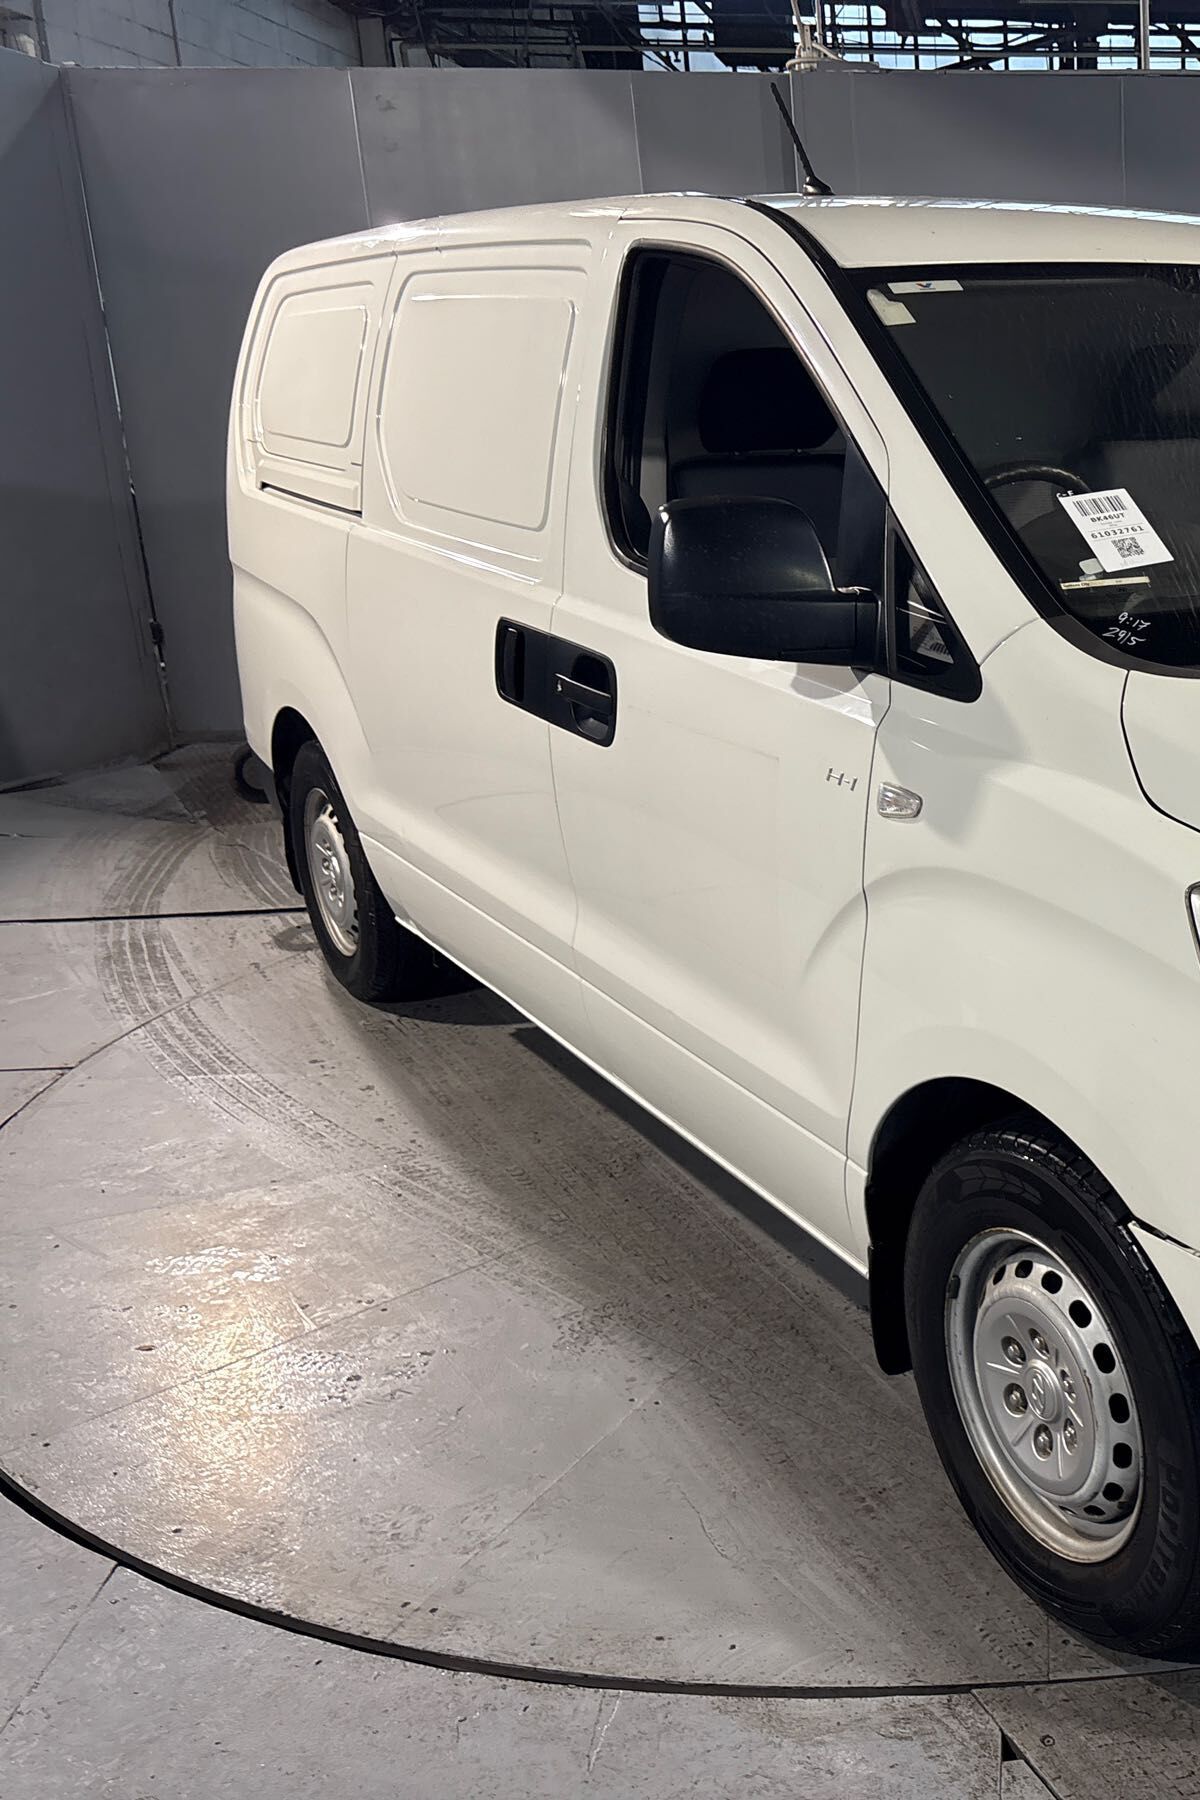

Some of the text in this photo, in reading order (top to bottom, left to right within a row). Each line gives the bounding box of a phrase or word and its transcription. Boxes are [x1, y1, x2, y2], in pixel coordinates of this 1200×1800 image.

[1091, 525, 1144, 539] 61032761
[1118, 612, 1151, 630] 9:17
[1102, 627, 1146, 645] 29/5
